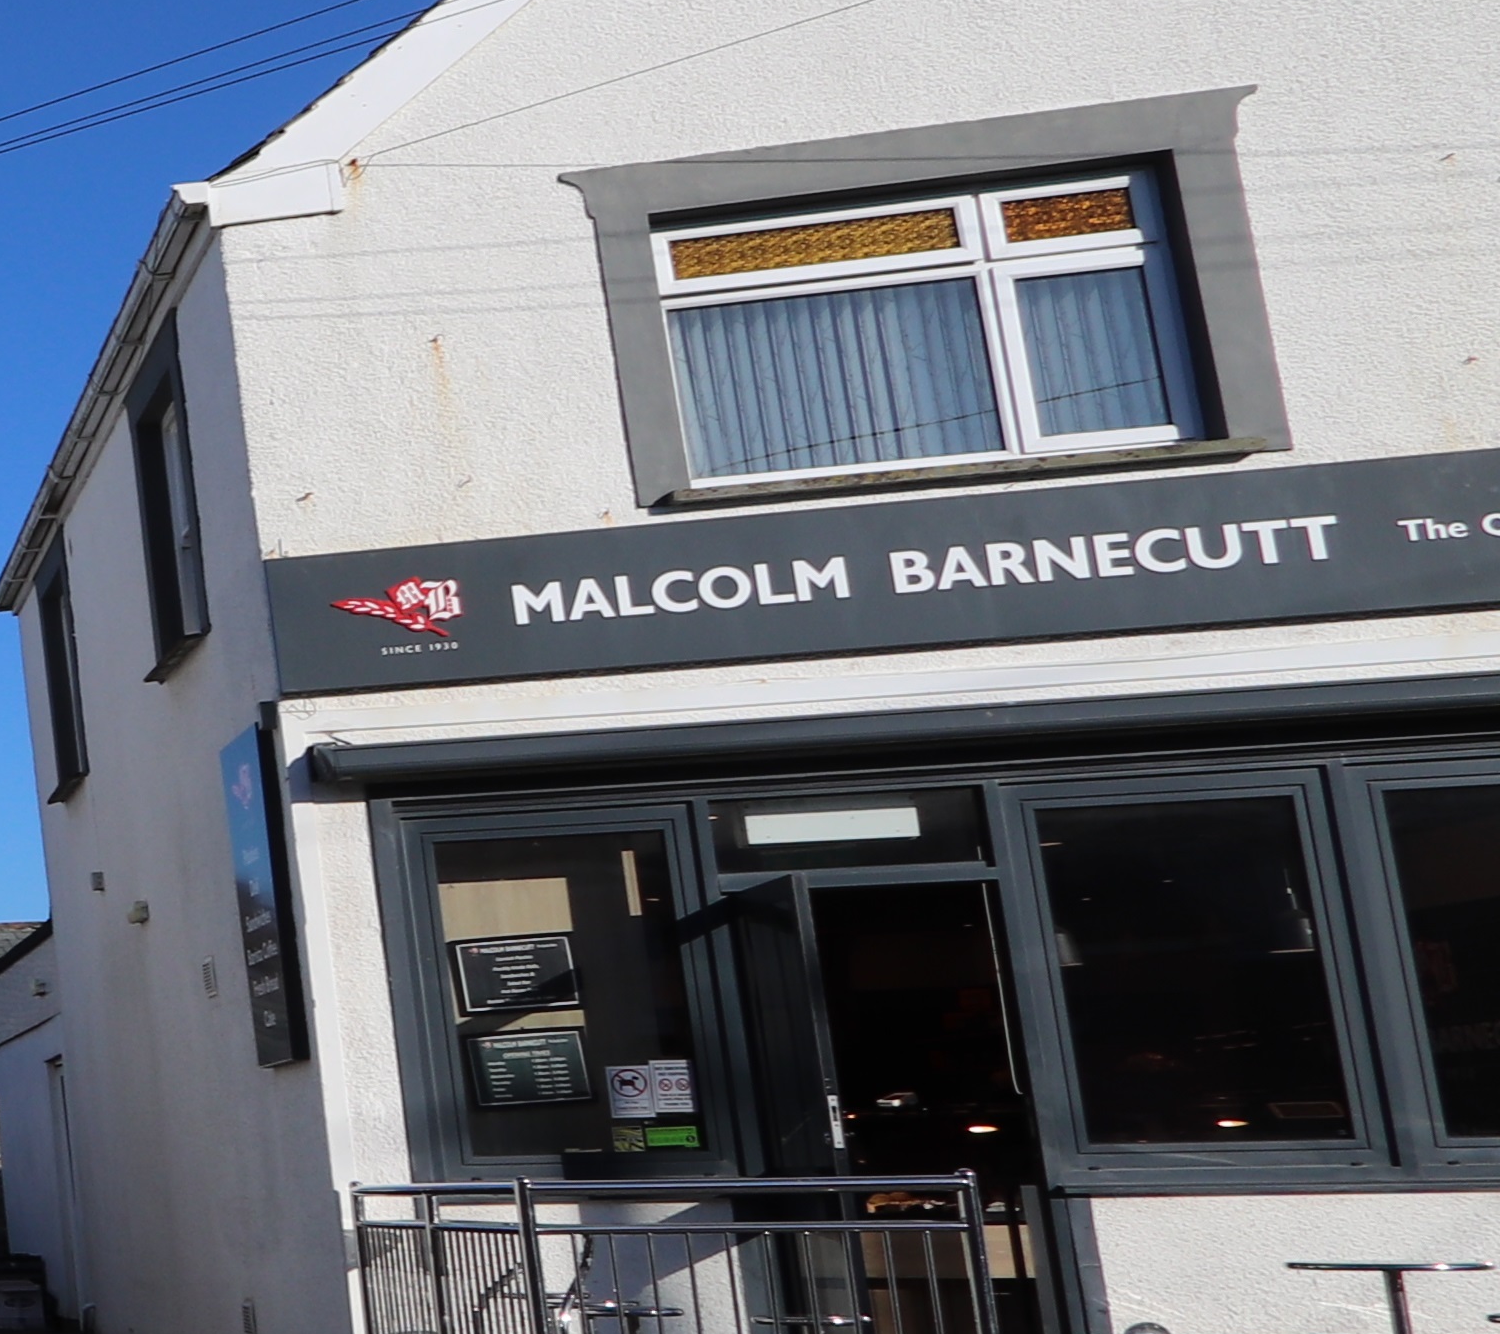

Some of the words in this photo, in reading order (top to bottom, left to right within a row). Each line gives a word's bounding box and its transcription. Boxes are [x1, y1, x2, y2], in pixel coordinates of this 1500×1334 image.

[1397, 518, 1469, 541] The
[511, 556, 850, 625] MALCOLM
[891, 516, 1338, 594] BARNECUTT
[381, 644, 422, 656] SINCE
[429, 641, 459, 651] 1930
